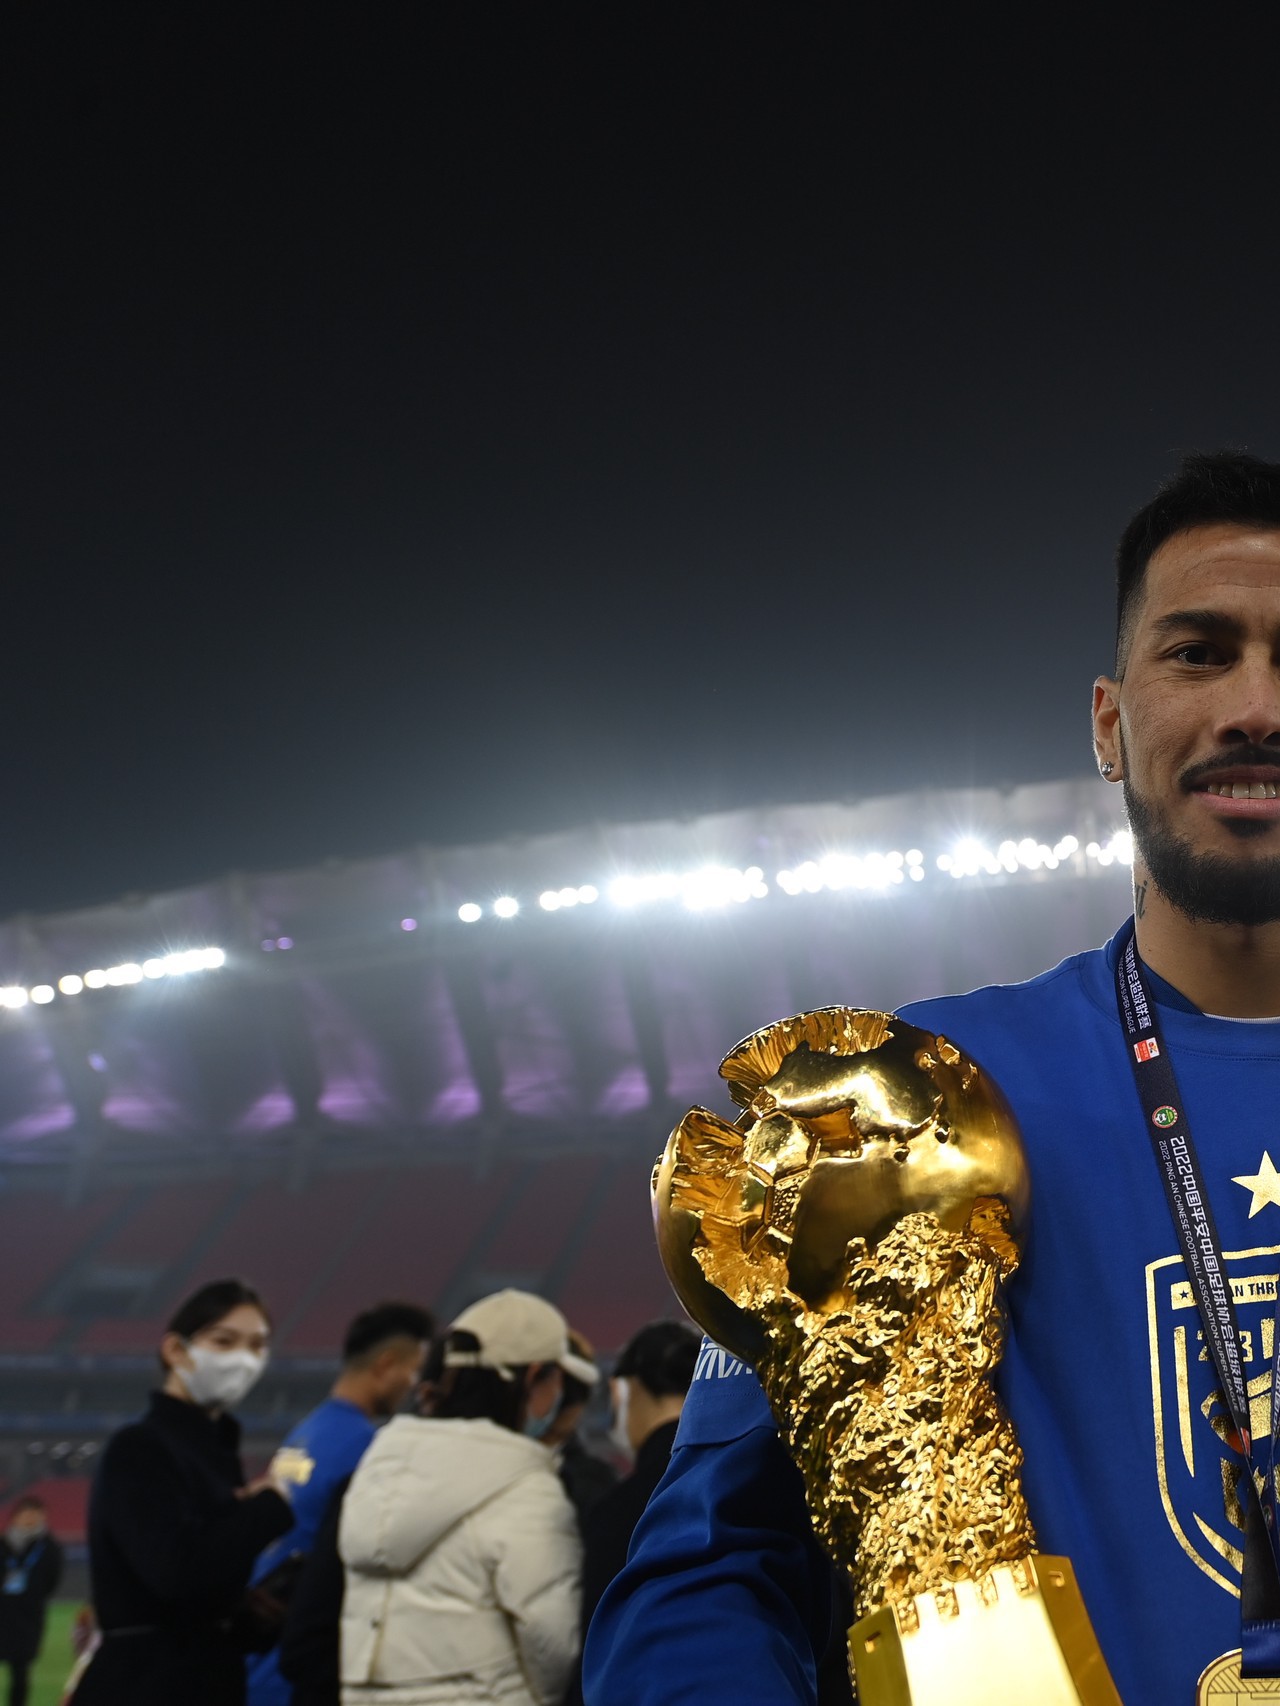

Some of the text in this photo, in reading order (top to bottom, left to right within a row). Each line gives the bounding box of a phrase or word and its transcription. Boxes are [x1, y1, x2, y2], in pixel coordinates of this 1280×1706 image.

[1121, 988, 1129, 1009] SUPER
[1125, 1009, 1136, 1034] LEAGUE
[1158, 1140, 1170, 1160] 2022
[1165, 1161, 1173, 1181] PING
[1170, 1182, 1179, 1194] AN
[1173, 1194, 1190, 1230] CHINESE
[1184, 1230, 1201, 1276] FOOTBALL
[1197, 1278, 1219, 1339] ASSOCIATION
[1214, 1339, 1228, 1372] SUPER
[1224, 1372, 1238, 1413] LEAGUE
